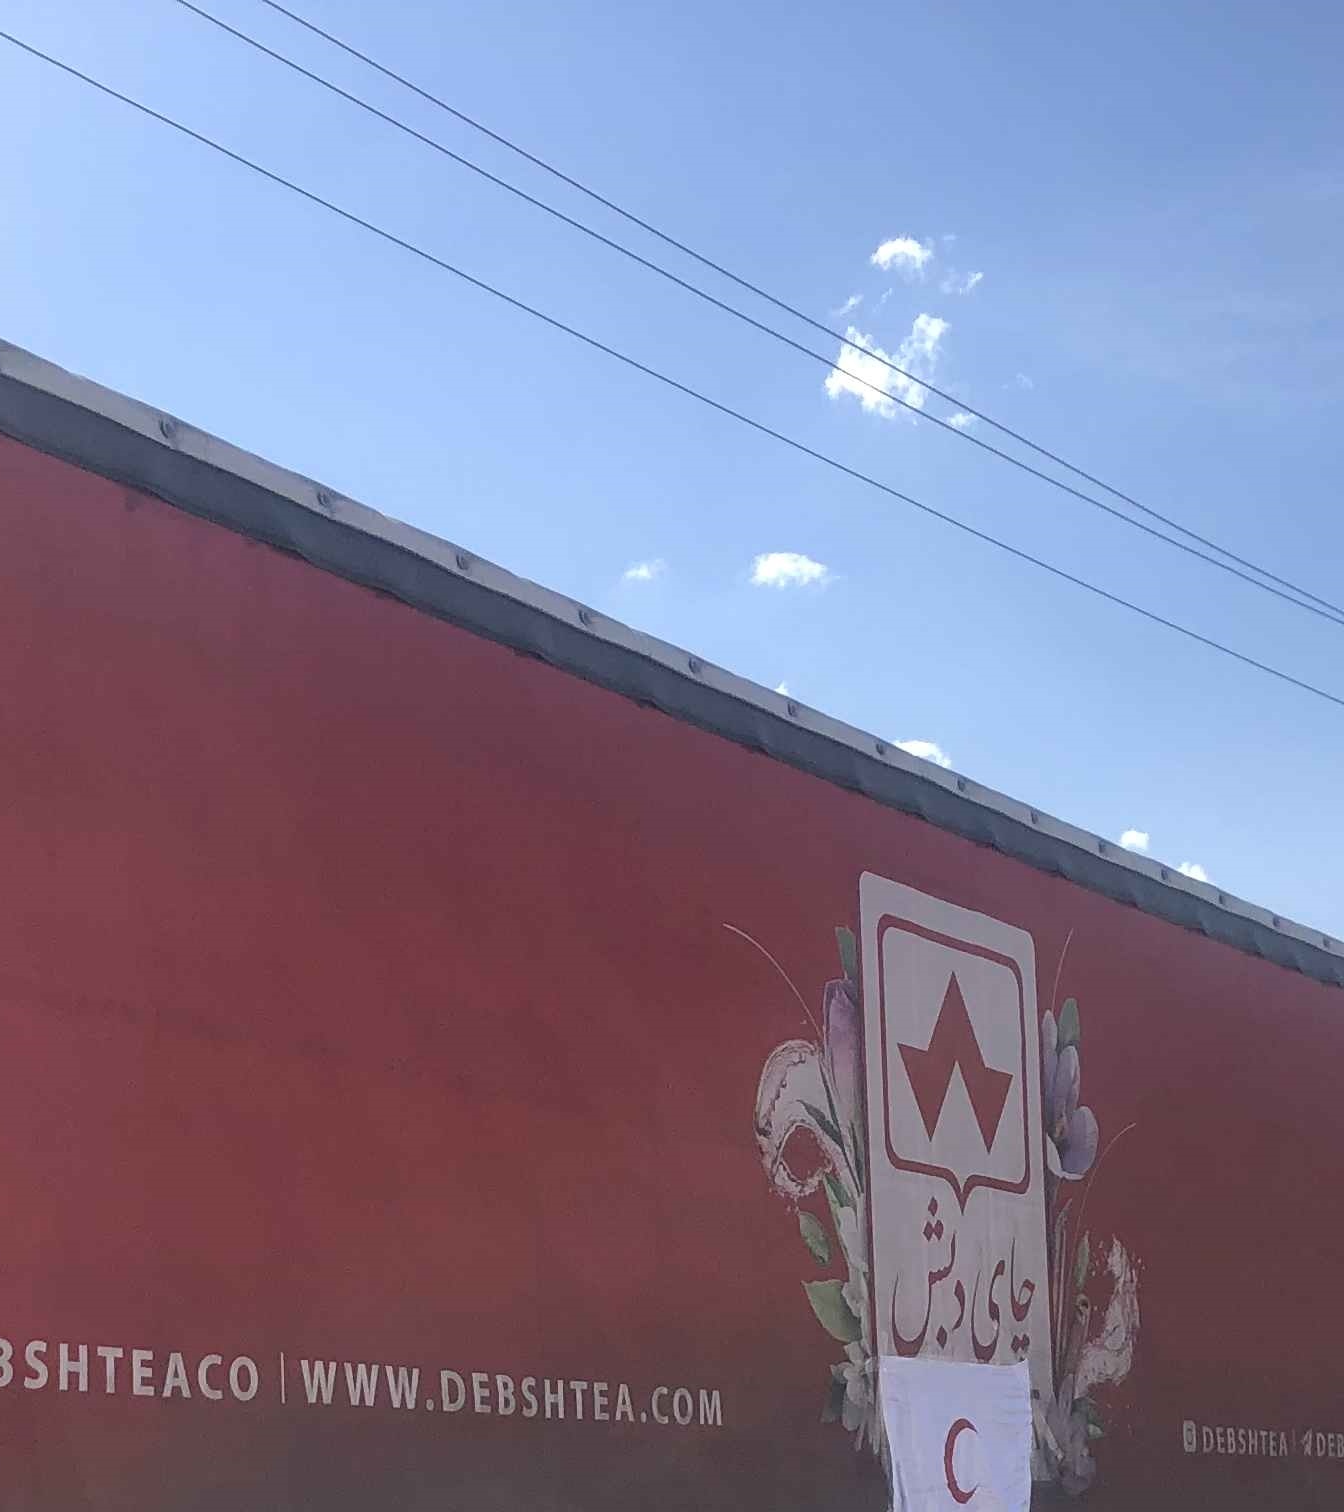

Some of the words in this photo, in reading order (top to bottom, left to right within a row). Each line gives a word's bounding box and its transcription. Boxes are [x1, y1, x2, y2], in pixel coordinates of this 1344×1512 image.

[971, 1235, 1036, 1362] چای
[300, 1358, 725, 1428] WWW.DEBSHTEA.COM
[1202, 1426, 1288, 1457] DEBSHTEA
